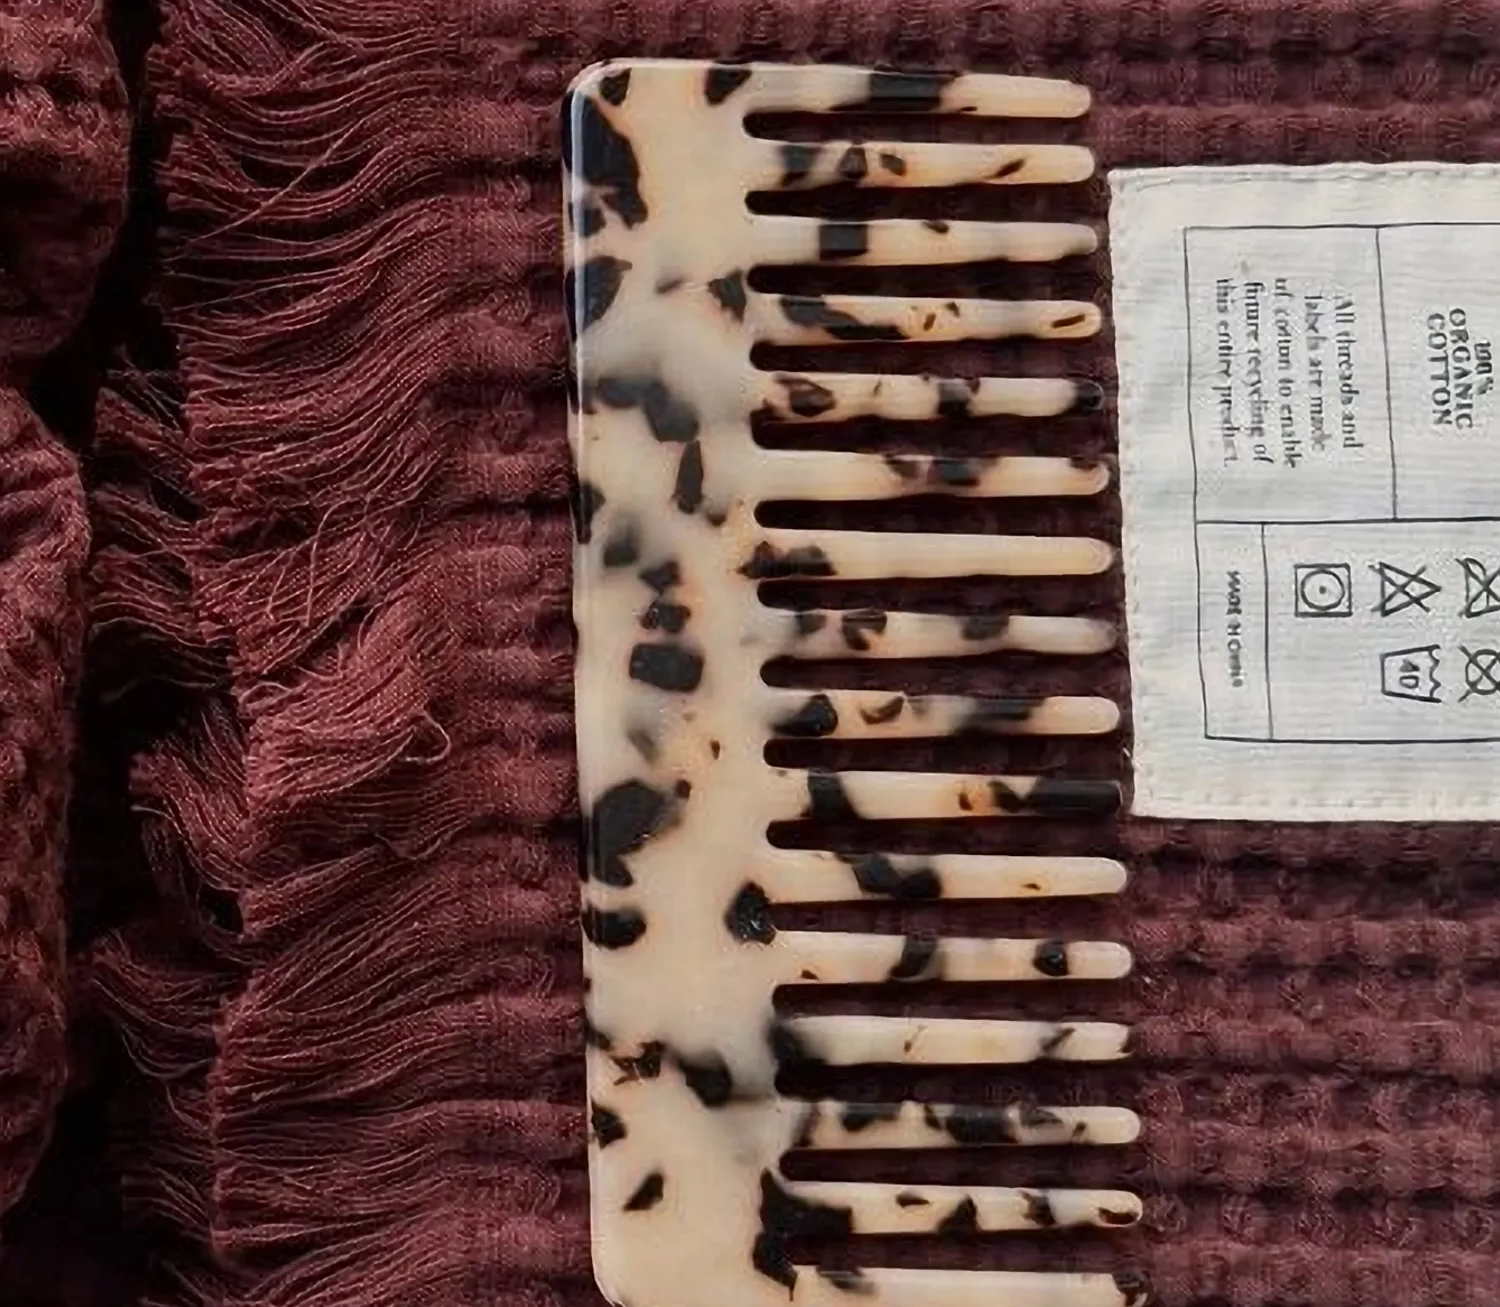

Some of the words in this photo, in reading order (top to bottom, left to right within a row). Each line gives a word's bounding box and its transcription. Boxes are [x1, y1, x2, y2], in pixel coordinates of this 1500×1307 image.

[1217, 279, 1234, 314] this
[1245, 282, 1263, 341] future
[1273, 278, 1294, 298] of
[1334, 296, 1356, 323] All
[1279, 378, 1294, 397] to
[1336, 332, 1360, 406] threads
[1427, 314, 1452, 425] COTTON
[1449, 308, 1473, 430] ORGANIC
[1474, 342, 1493, 396] 100%
[1242, 349, 1270, 438] recycling
[1342, 408, 1364, 449] and
[1253, 444, 1274, 464] of
